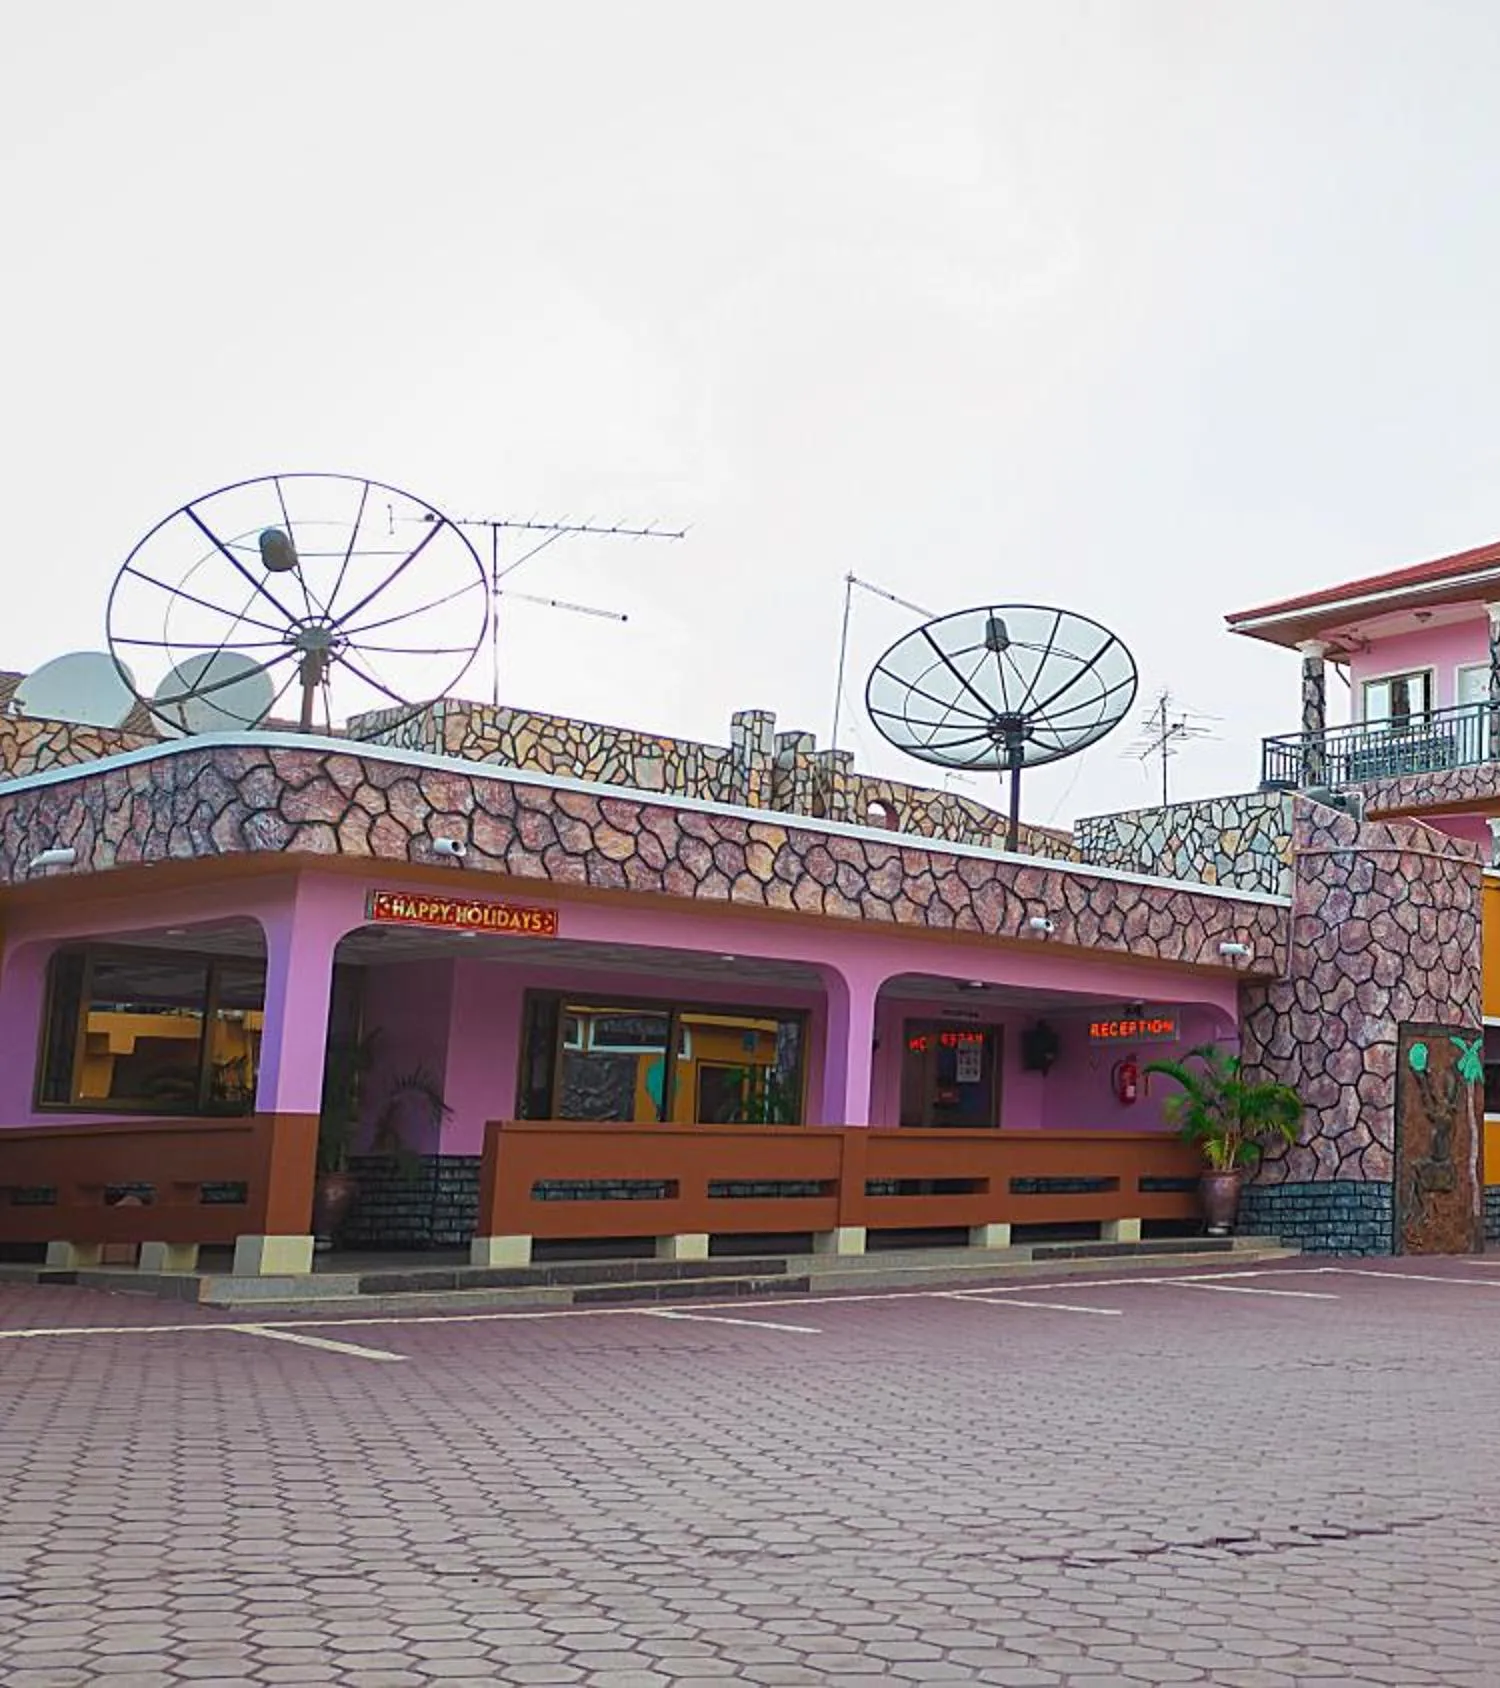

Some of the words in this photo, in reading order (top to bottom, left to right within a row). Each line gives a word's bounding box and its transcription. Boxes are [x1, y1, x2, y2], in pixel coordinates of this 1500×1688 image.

[392, 899, 449, 921] HAPPY
[456, 904, 542, 930] HOLIDAYS
[1090, 1020, 1174, 1037] RECEPTION
